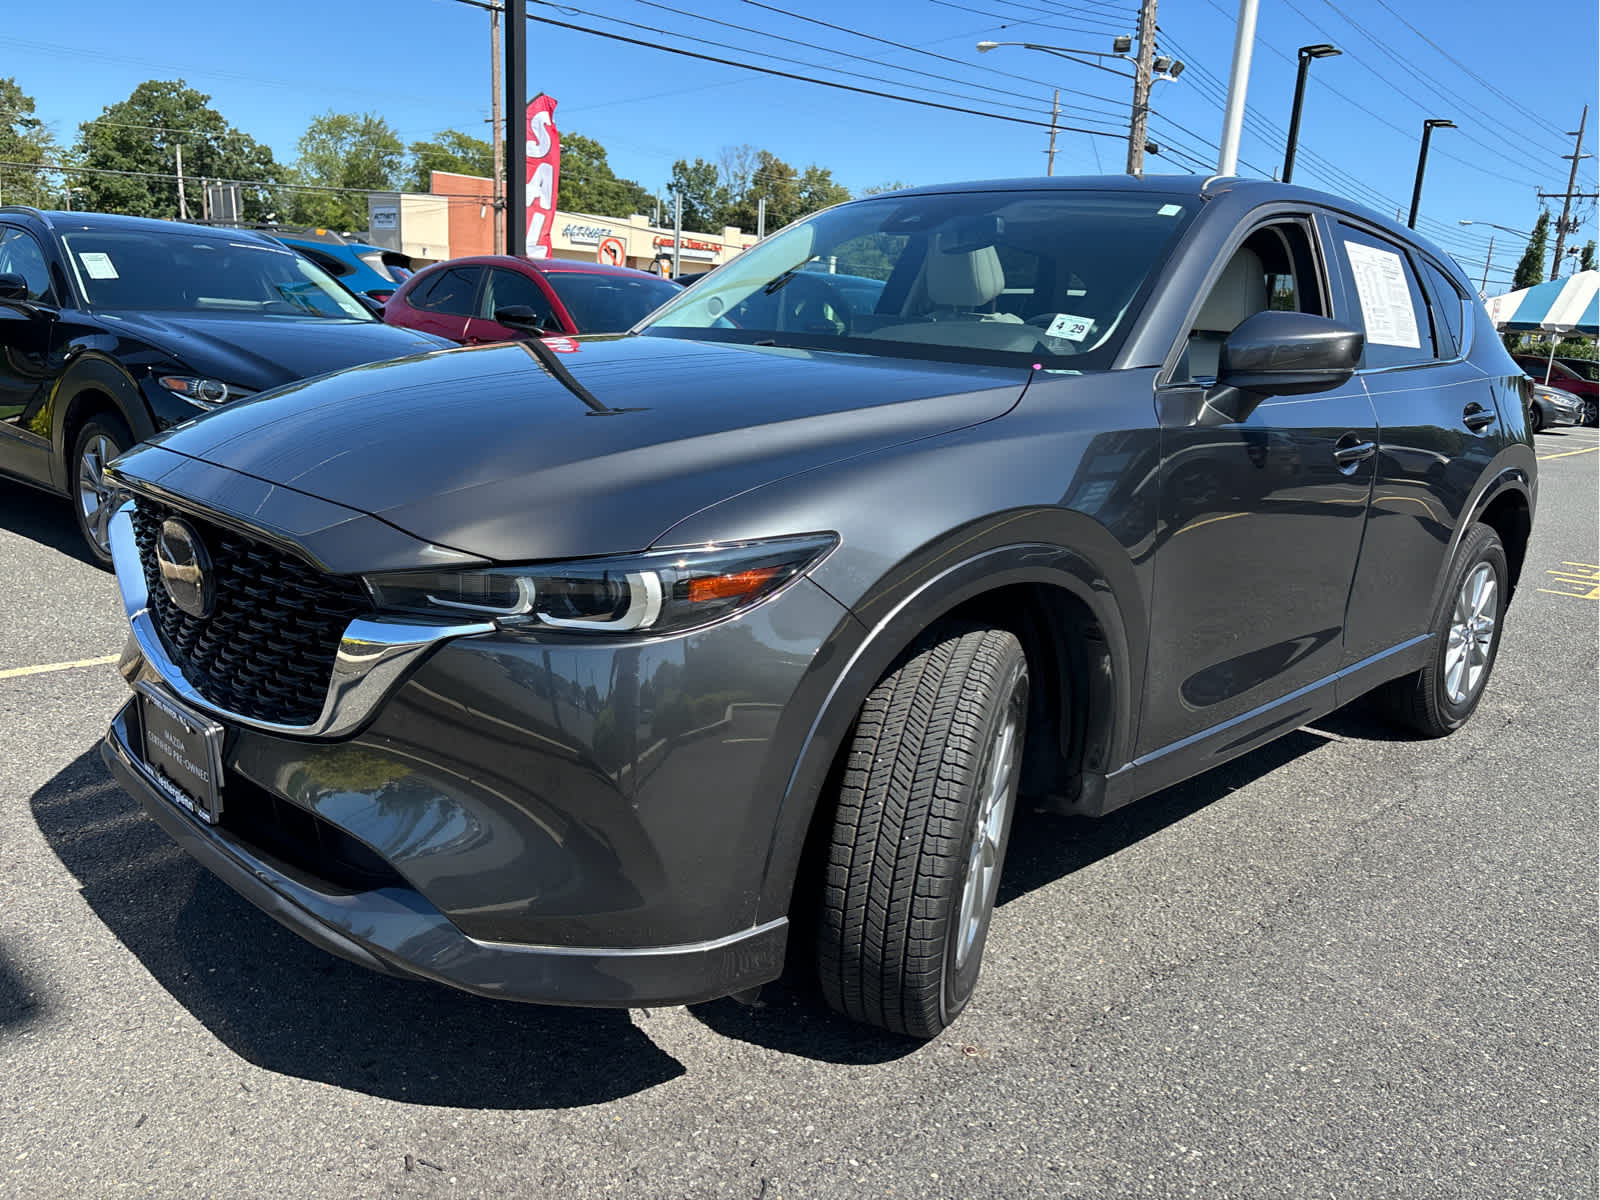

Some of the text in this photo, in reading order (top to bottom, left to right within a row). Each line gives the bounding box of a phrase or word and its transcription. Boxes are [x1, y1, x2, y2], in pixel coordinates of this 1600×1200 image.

[1056, 321, 1065, 330] 4
[1070, 323, 1085, 334] 29
[164, 729, 185, 752] MAZDA
